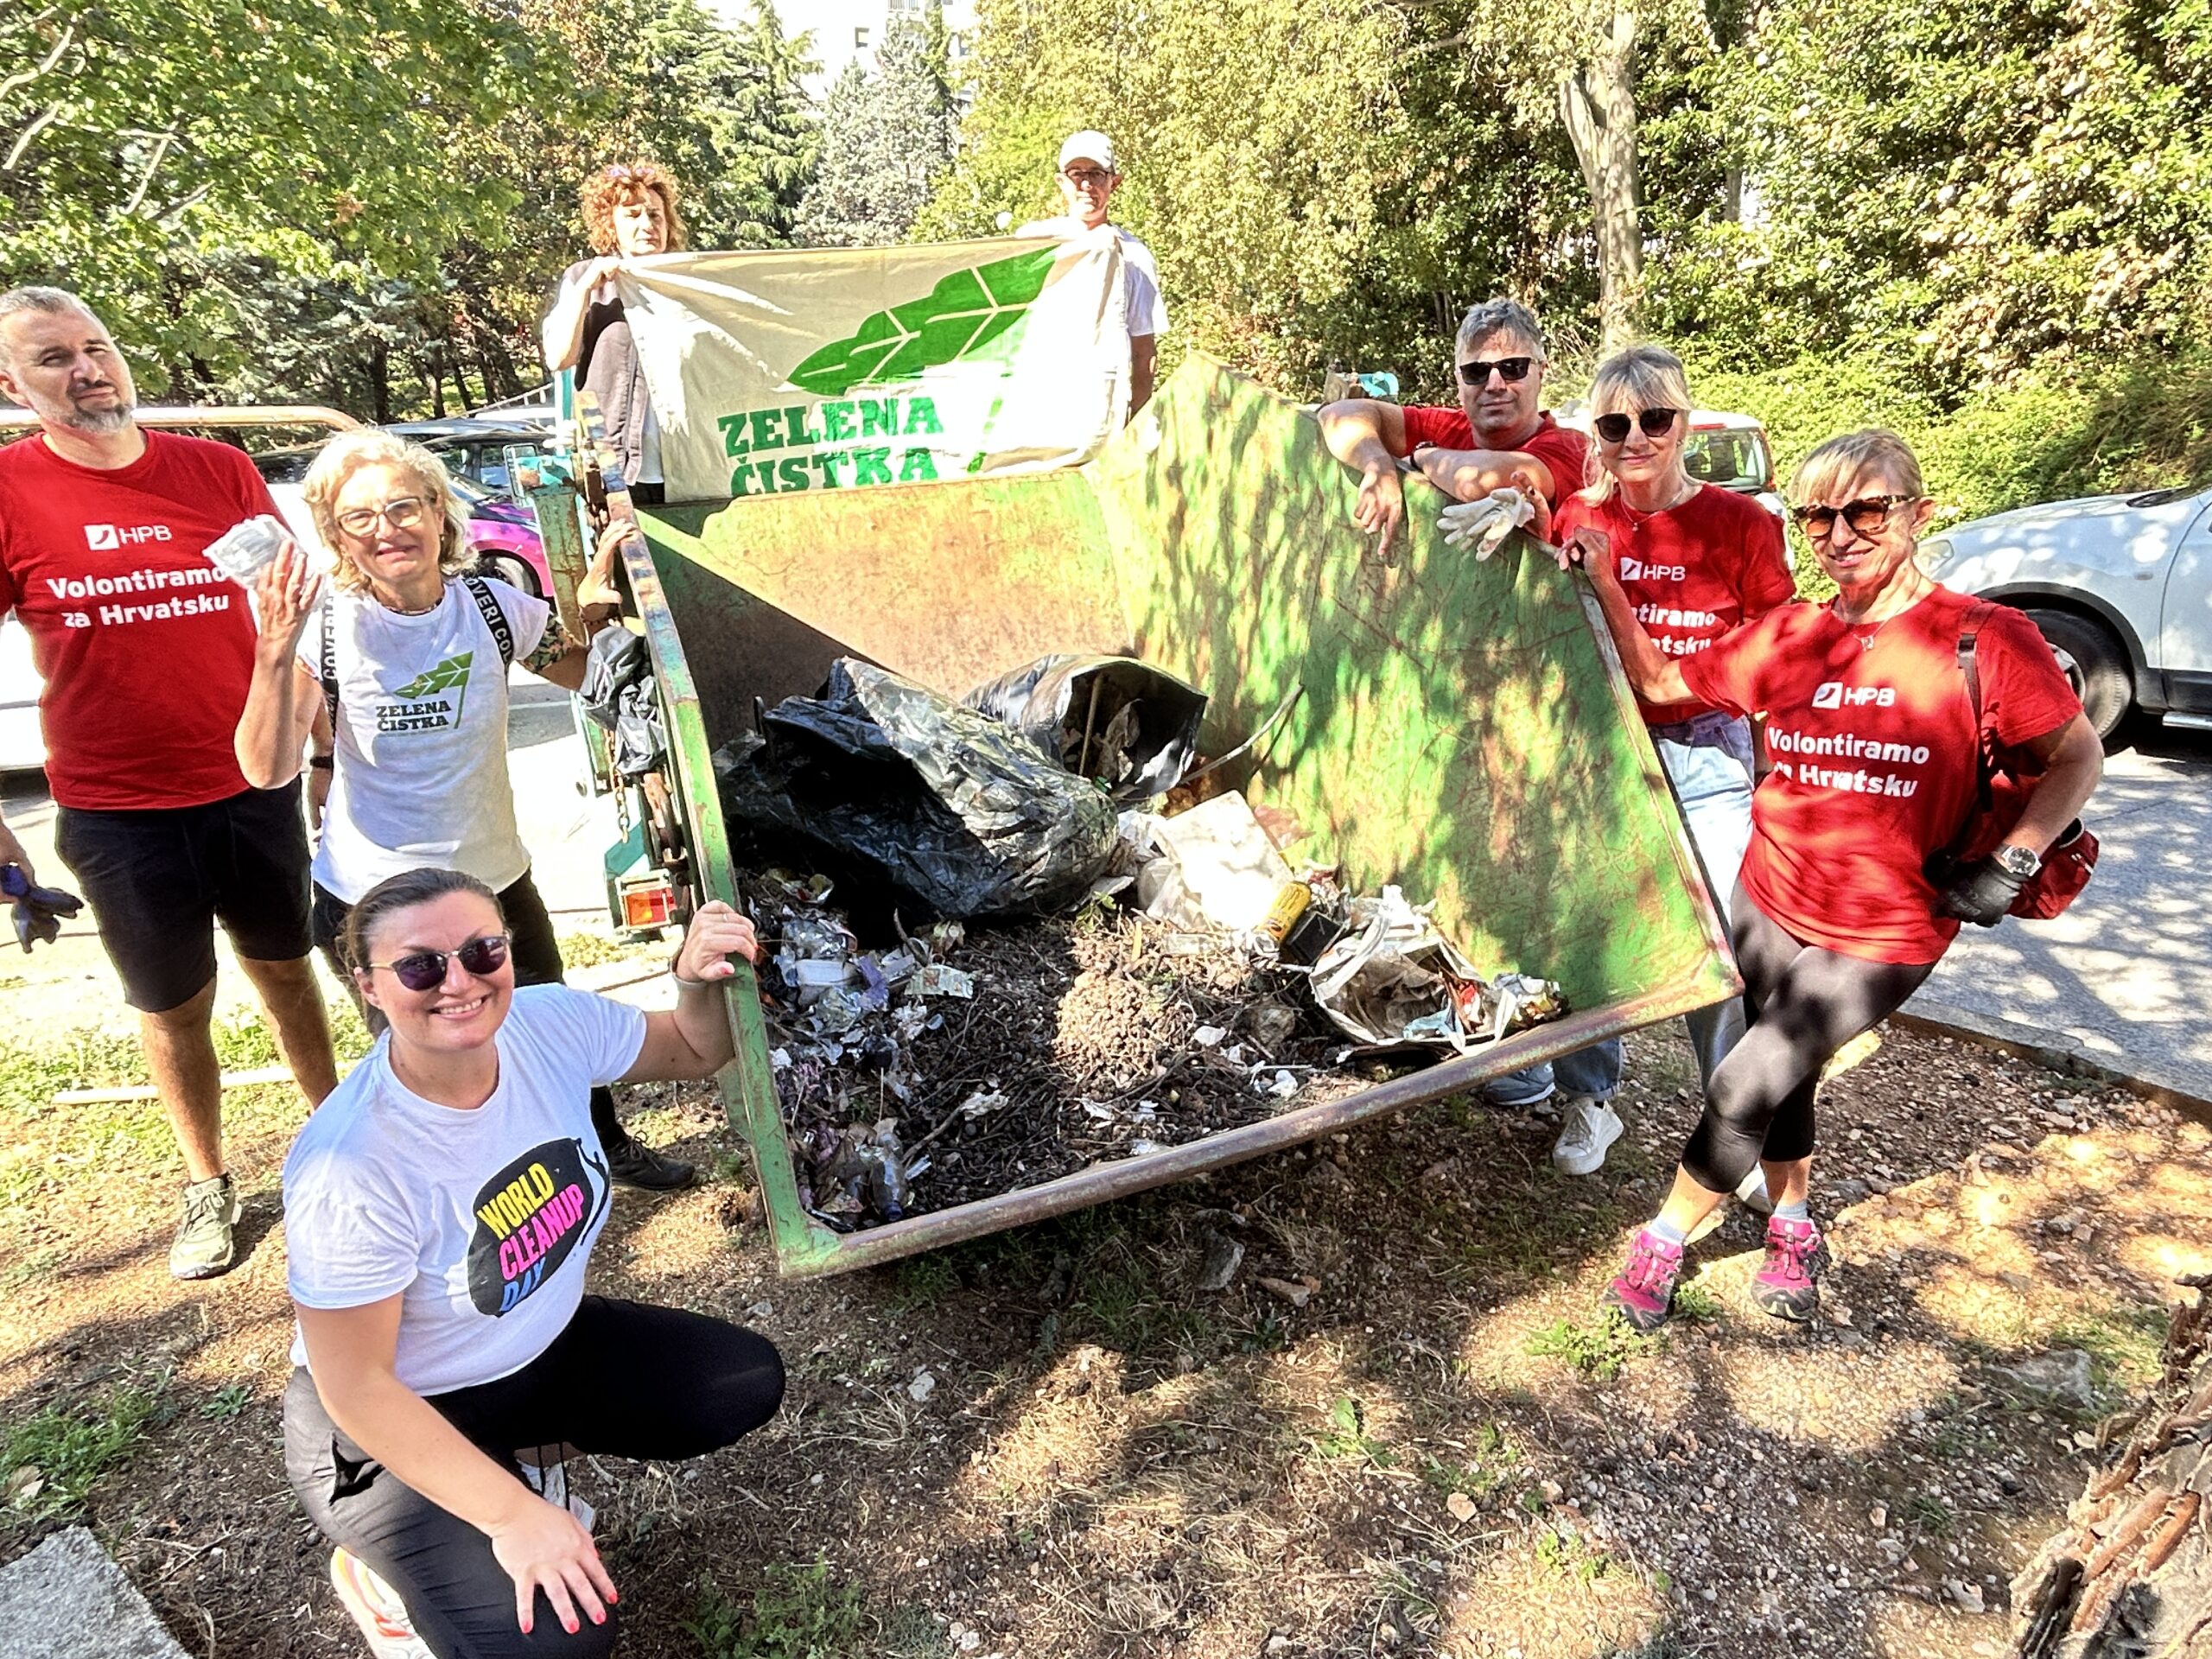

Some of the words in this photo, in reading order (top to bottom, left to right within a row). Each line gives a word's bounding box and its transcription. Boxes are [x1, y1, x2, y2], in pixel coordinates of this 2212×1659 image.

[716, 397, 944, 458] ZELENA
[731, 446, 938, 497] ČISTKA
[118, 525, 172, 544] HPB
[47, 567, 226, 599] Volontiramo
[1643, 564, 1686, 582] HPB
[61, 612, 92, 628] za
[99, 594, 229, 626] Hrvatsku
[376, 700, 451, 717] ZELENA
[1844, 687, 1896, 707] HPB
[378, 715, 449, 732] ČISTKA
[1769, 727, 1930, 765] Volontiramo
[476, 1162, 555, 1240] WORLD
[499, 1184, 584, 1281] CLEANUP
